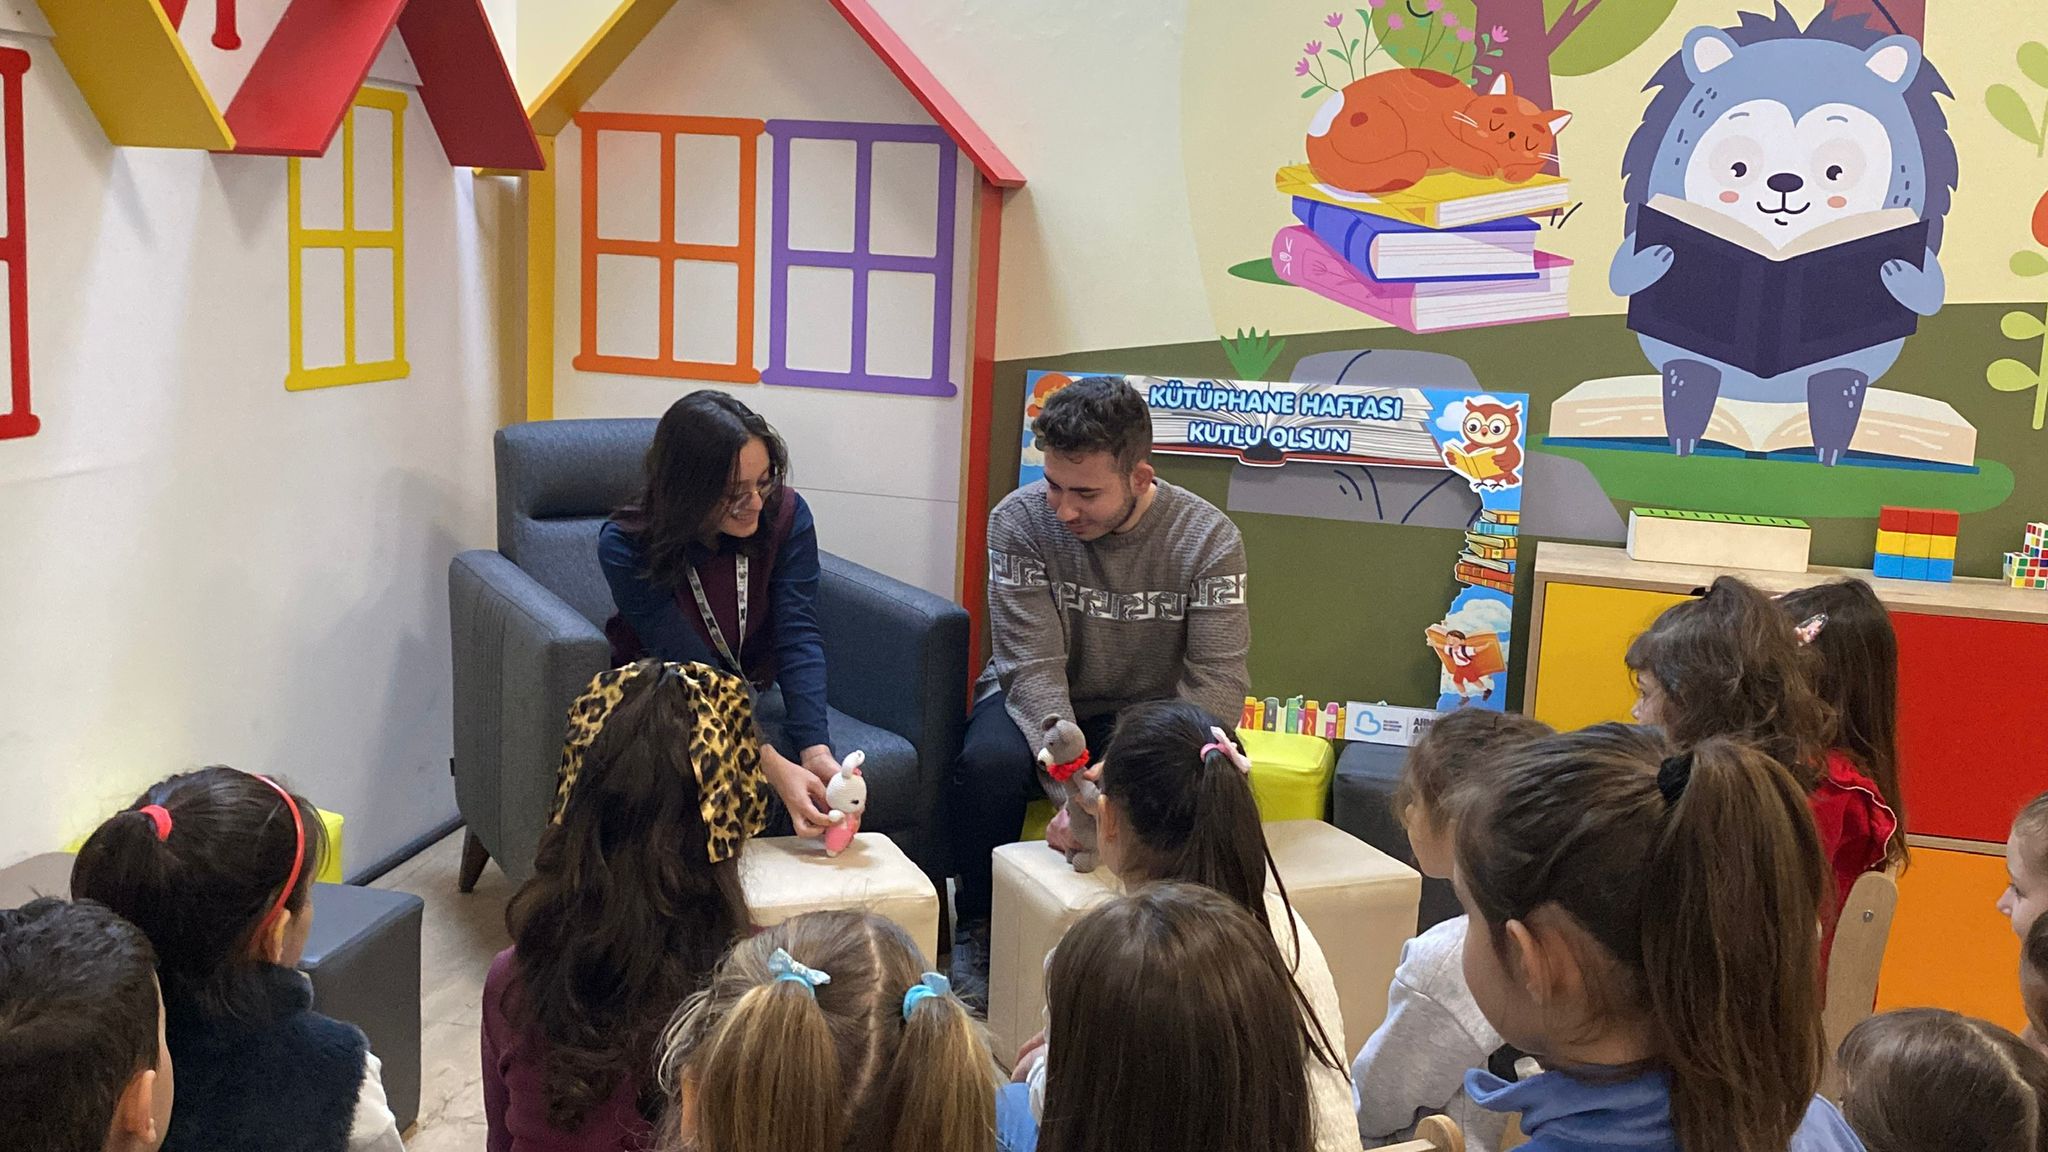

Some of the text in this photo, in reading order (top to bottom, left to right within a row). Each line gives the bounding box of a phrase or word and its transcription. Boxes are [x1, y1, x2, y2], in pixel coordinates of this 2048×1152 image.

[1150, 380, 1402, 420] KÜTÜPHANE HAFTASI
[1187, 421, 1352, 452] KUTLU OLSUN
